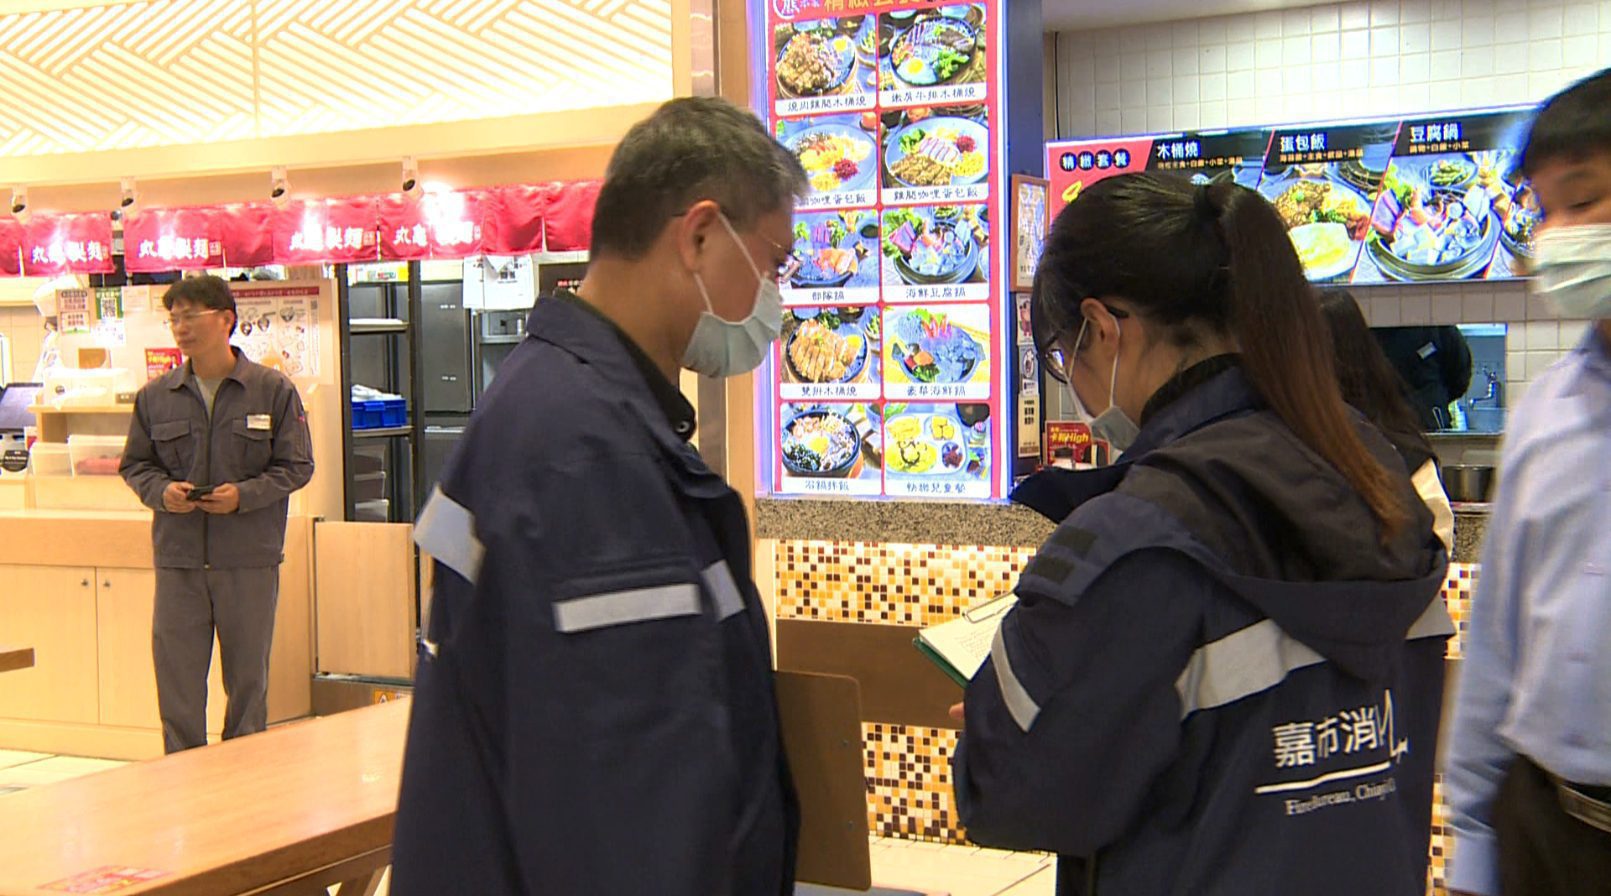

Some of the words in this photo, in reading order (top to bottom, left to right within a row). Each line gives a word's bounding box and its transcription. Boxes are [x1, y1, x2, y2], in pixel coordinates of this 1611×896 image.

[1410, 123, 1459, 143] 豆腐鍋
[1156, 141, 1199, 159] 木桶燒
[1280, 133, 1325, 153] 蛋包飯
[906, 287, 966, 299] 海鮮豆腐鍋
